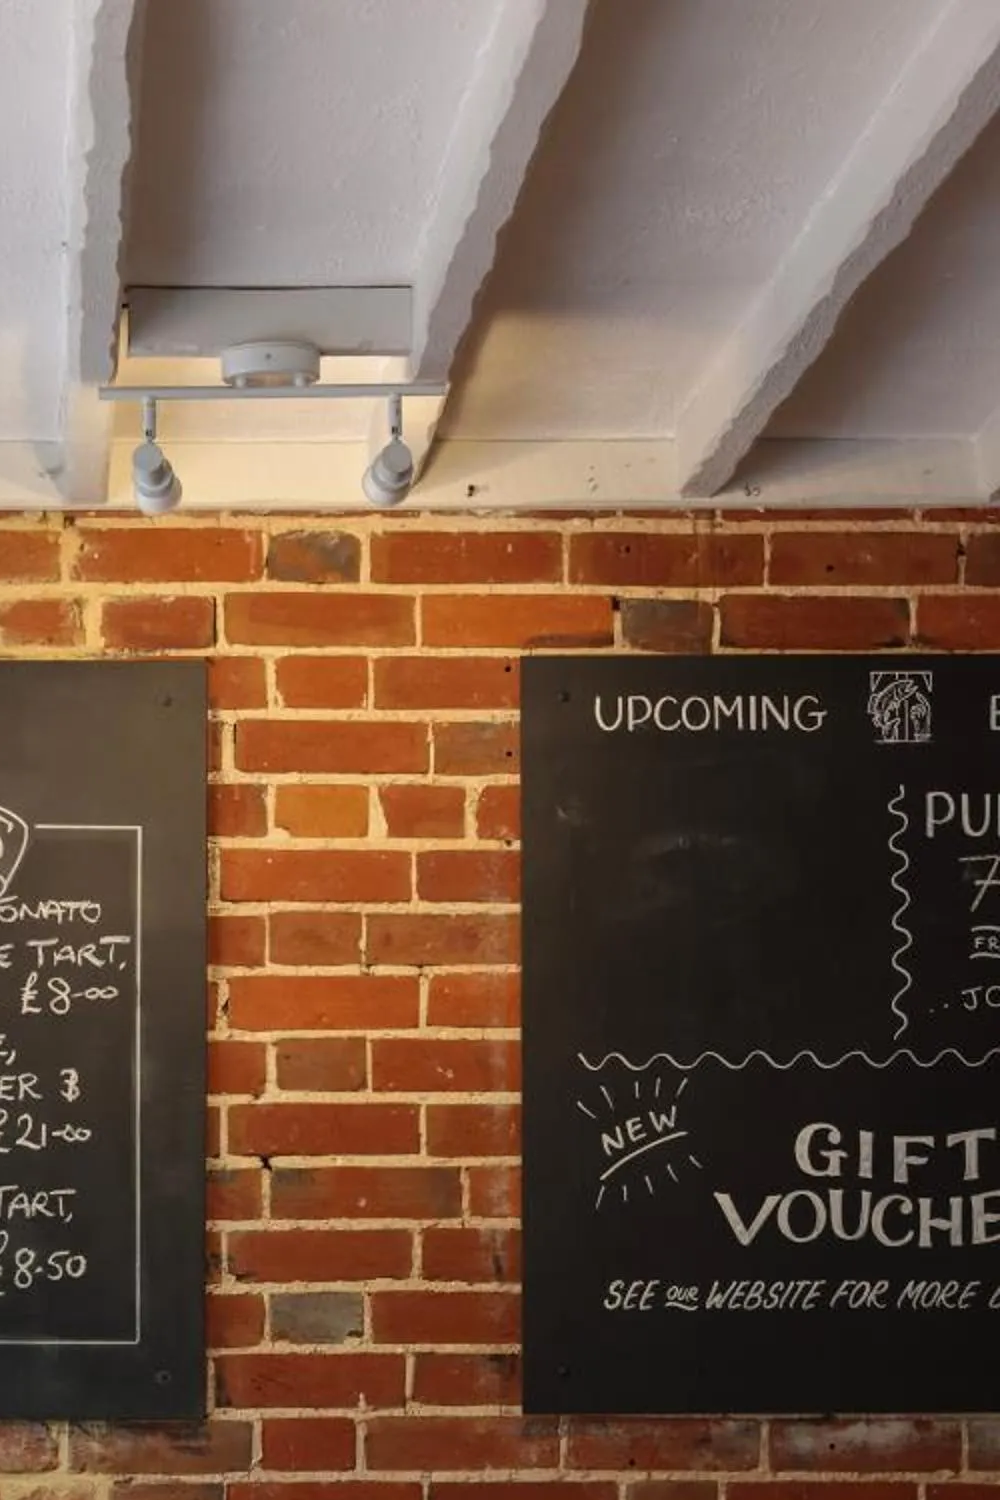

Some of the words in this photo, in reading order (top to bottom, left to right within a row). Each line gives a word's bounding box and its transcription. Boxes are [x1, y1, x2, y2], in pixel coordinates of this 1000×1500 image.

[594, 694, 828, 733] UPCOMING
[601, 1104, 678, 1156] NEW
[793, 1121, 997, 1185] GIFT
[603, 1279, 661, 1311] SEE
[704, 1279, 827, 1311] WEBSITE
[829, 1279, 889, 1309] FOR
[896, 1279, 981, 1310] MORE
